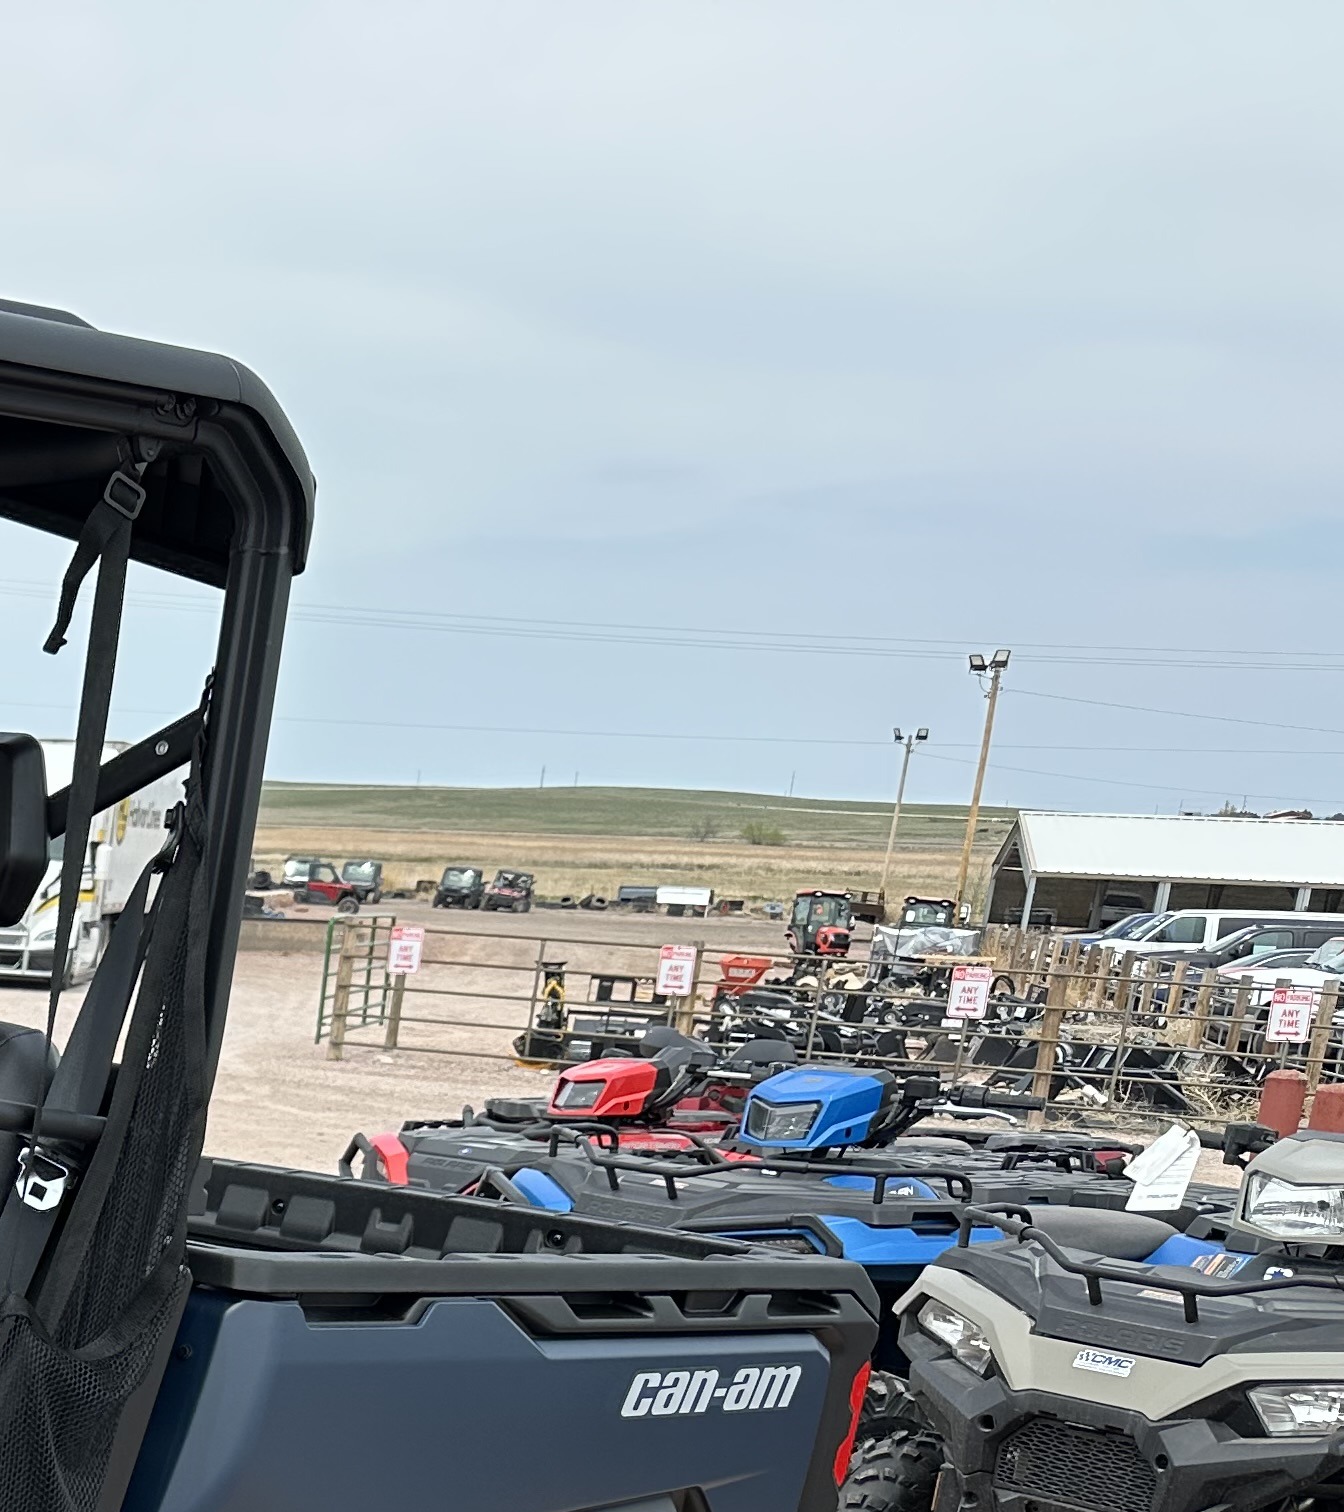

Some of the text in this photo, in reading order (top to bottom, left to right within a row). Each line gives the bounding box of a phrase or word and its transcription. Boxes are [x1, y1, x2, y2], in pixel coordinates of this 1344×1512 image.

[666, 974, 684, 982] TIME
[961, 986, 979, 994] ANY
[958, 996, 978, 1004] TIME
[1281, 1009, 1301, 1018] ANY
[1278, 1019, 1300, 1028] TIME
[1058, 1317, 1186, 1354] POLARIS
[1090, 1353, 1133, 1369] CMC
